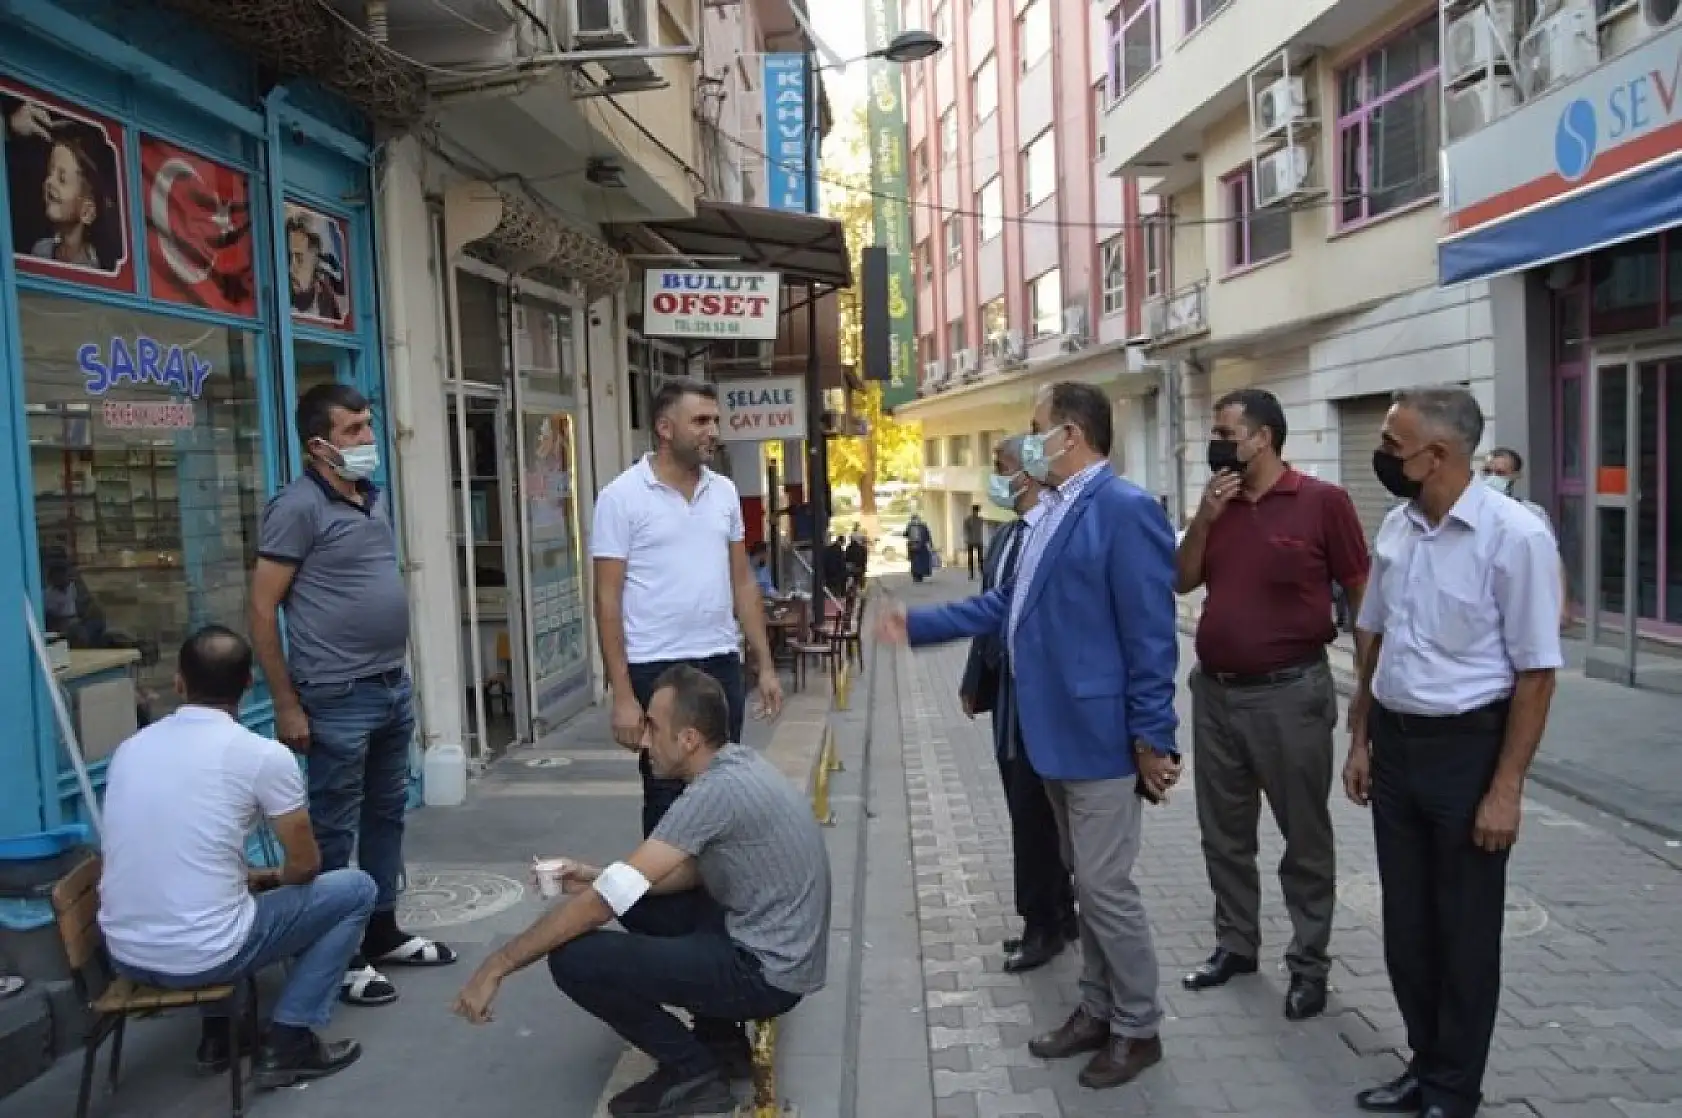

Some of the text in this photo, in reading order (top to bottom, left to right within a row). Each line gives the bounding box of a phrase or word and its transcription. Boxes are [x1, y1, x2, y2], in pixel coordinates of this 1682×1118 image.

[661, 273, 766, 290] BULUT
[653, 292, 770, 318] OFSET
[78, 336, 213, 399] SARAY
[726, 388, 794, 412] ŞELALE
[729, 408, 795, 432] ÇAY EVİ
